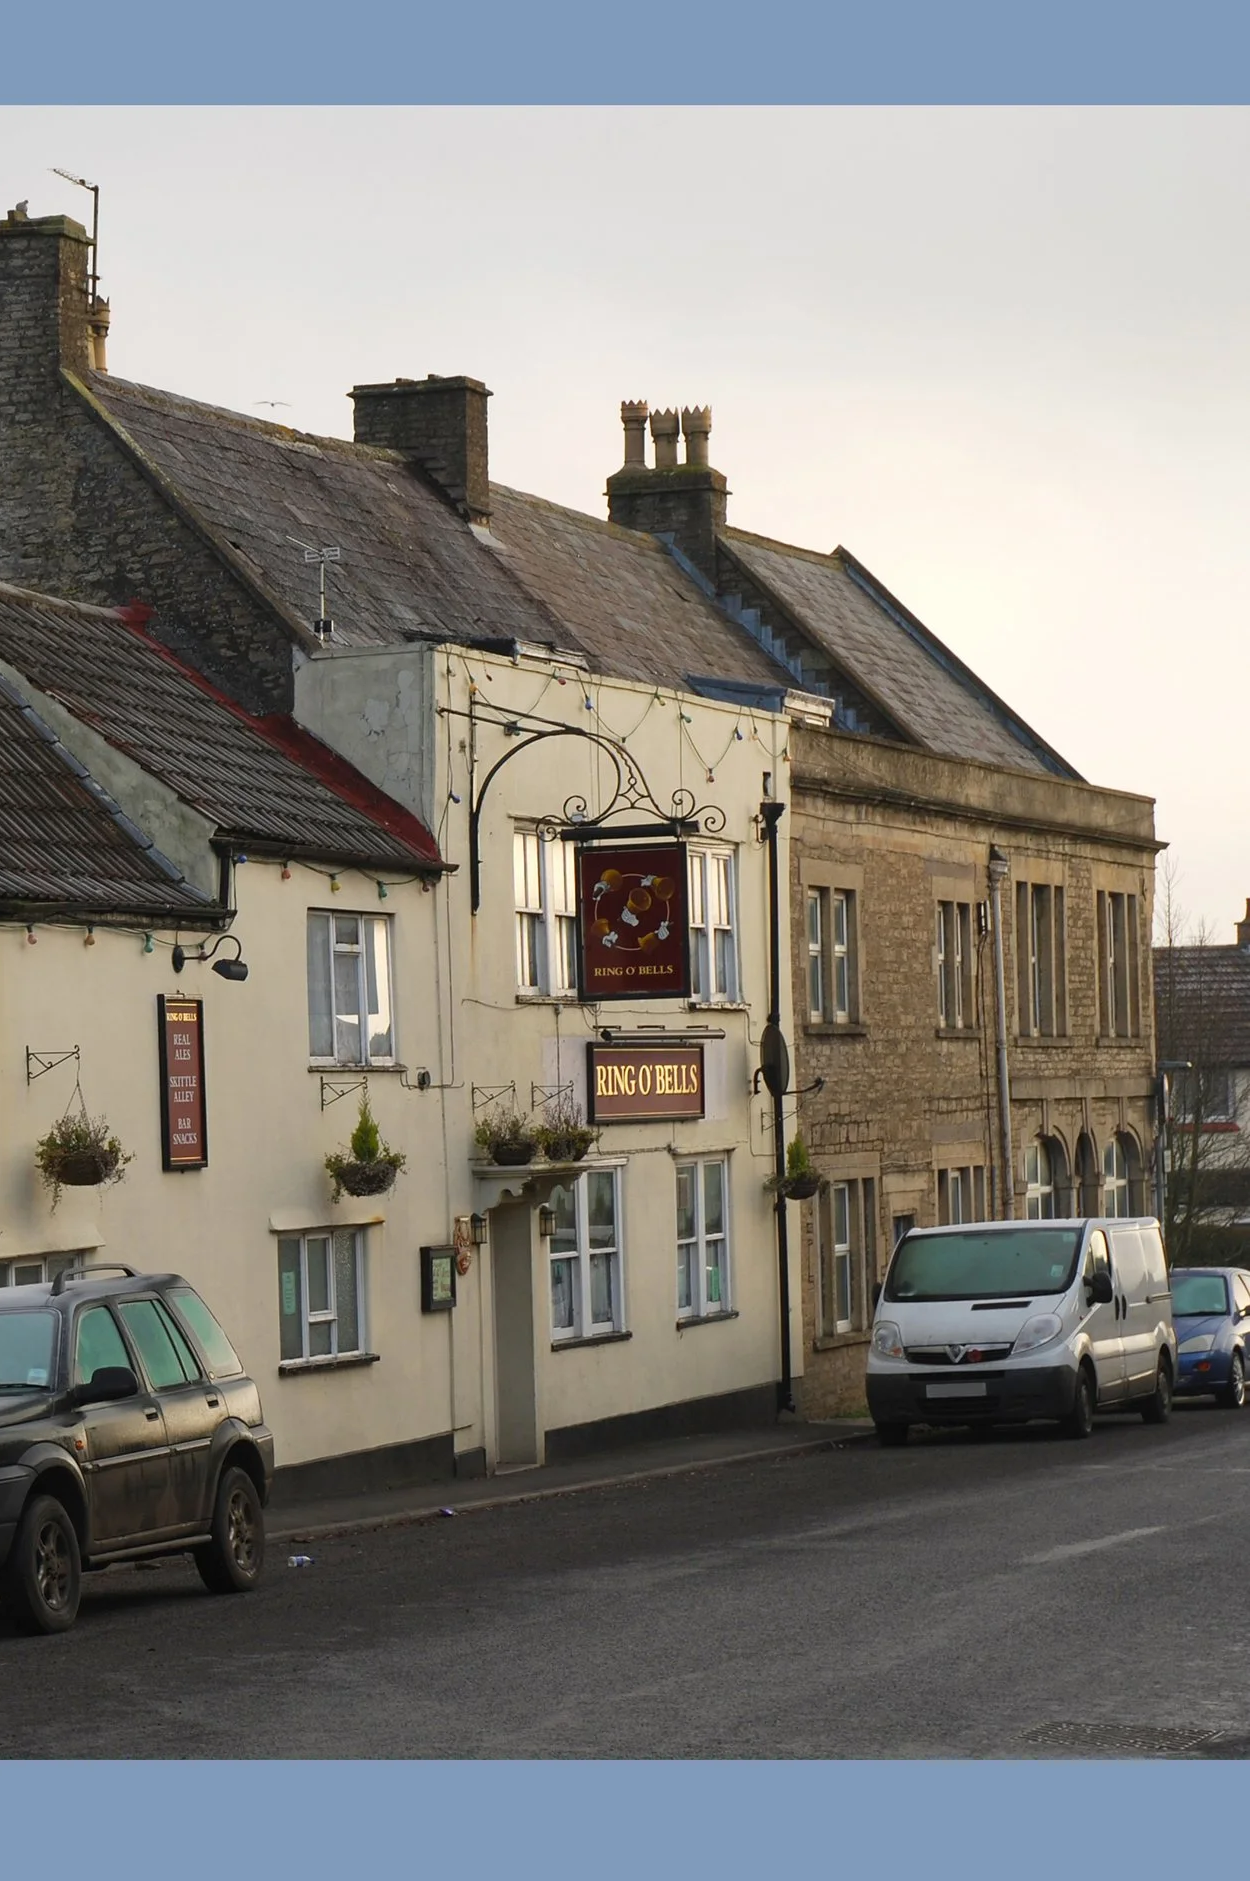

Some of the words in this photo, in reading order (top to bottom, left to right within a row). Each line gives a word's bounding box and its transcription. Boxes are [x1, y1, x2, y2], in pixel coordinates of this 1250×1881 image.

[594, 967, 623, 977] RING
[625, 966, 636, 976] O'
[638, 965, 674, 975] BELLS
[166, 1012, 178, 1022] RING
[183, 1012, 197, 1022] BELLS
[173, 1034, 191, 1046] REAL
[174, 1048, 191, 1060] ALES
[169, 1075, 197, 1088] SKITTLE
[596, 1065, 637, 1096] RING
[638, 1064, 653, 1096] O'
[654, 1064, 699, 1095] BELLS
[173, 1090, 195, 1103] ALLEY
[177, 1117, 192, 1130] BAR
[172, 1132, 198, 1145] SNACKS
